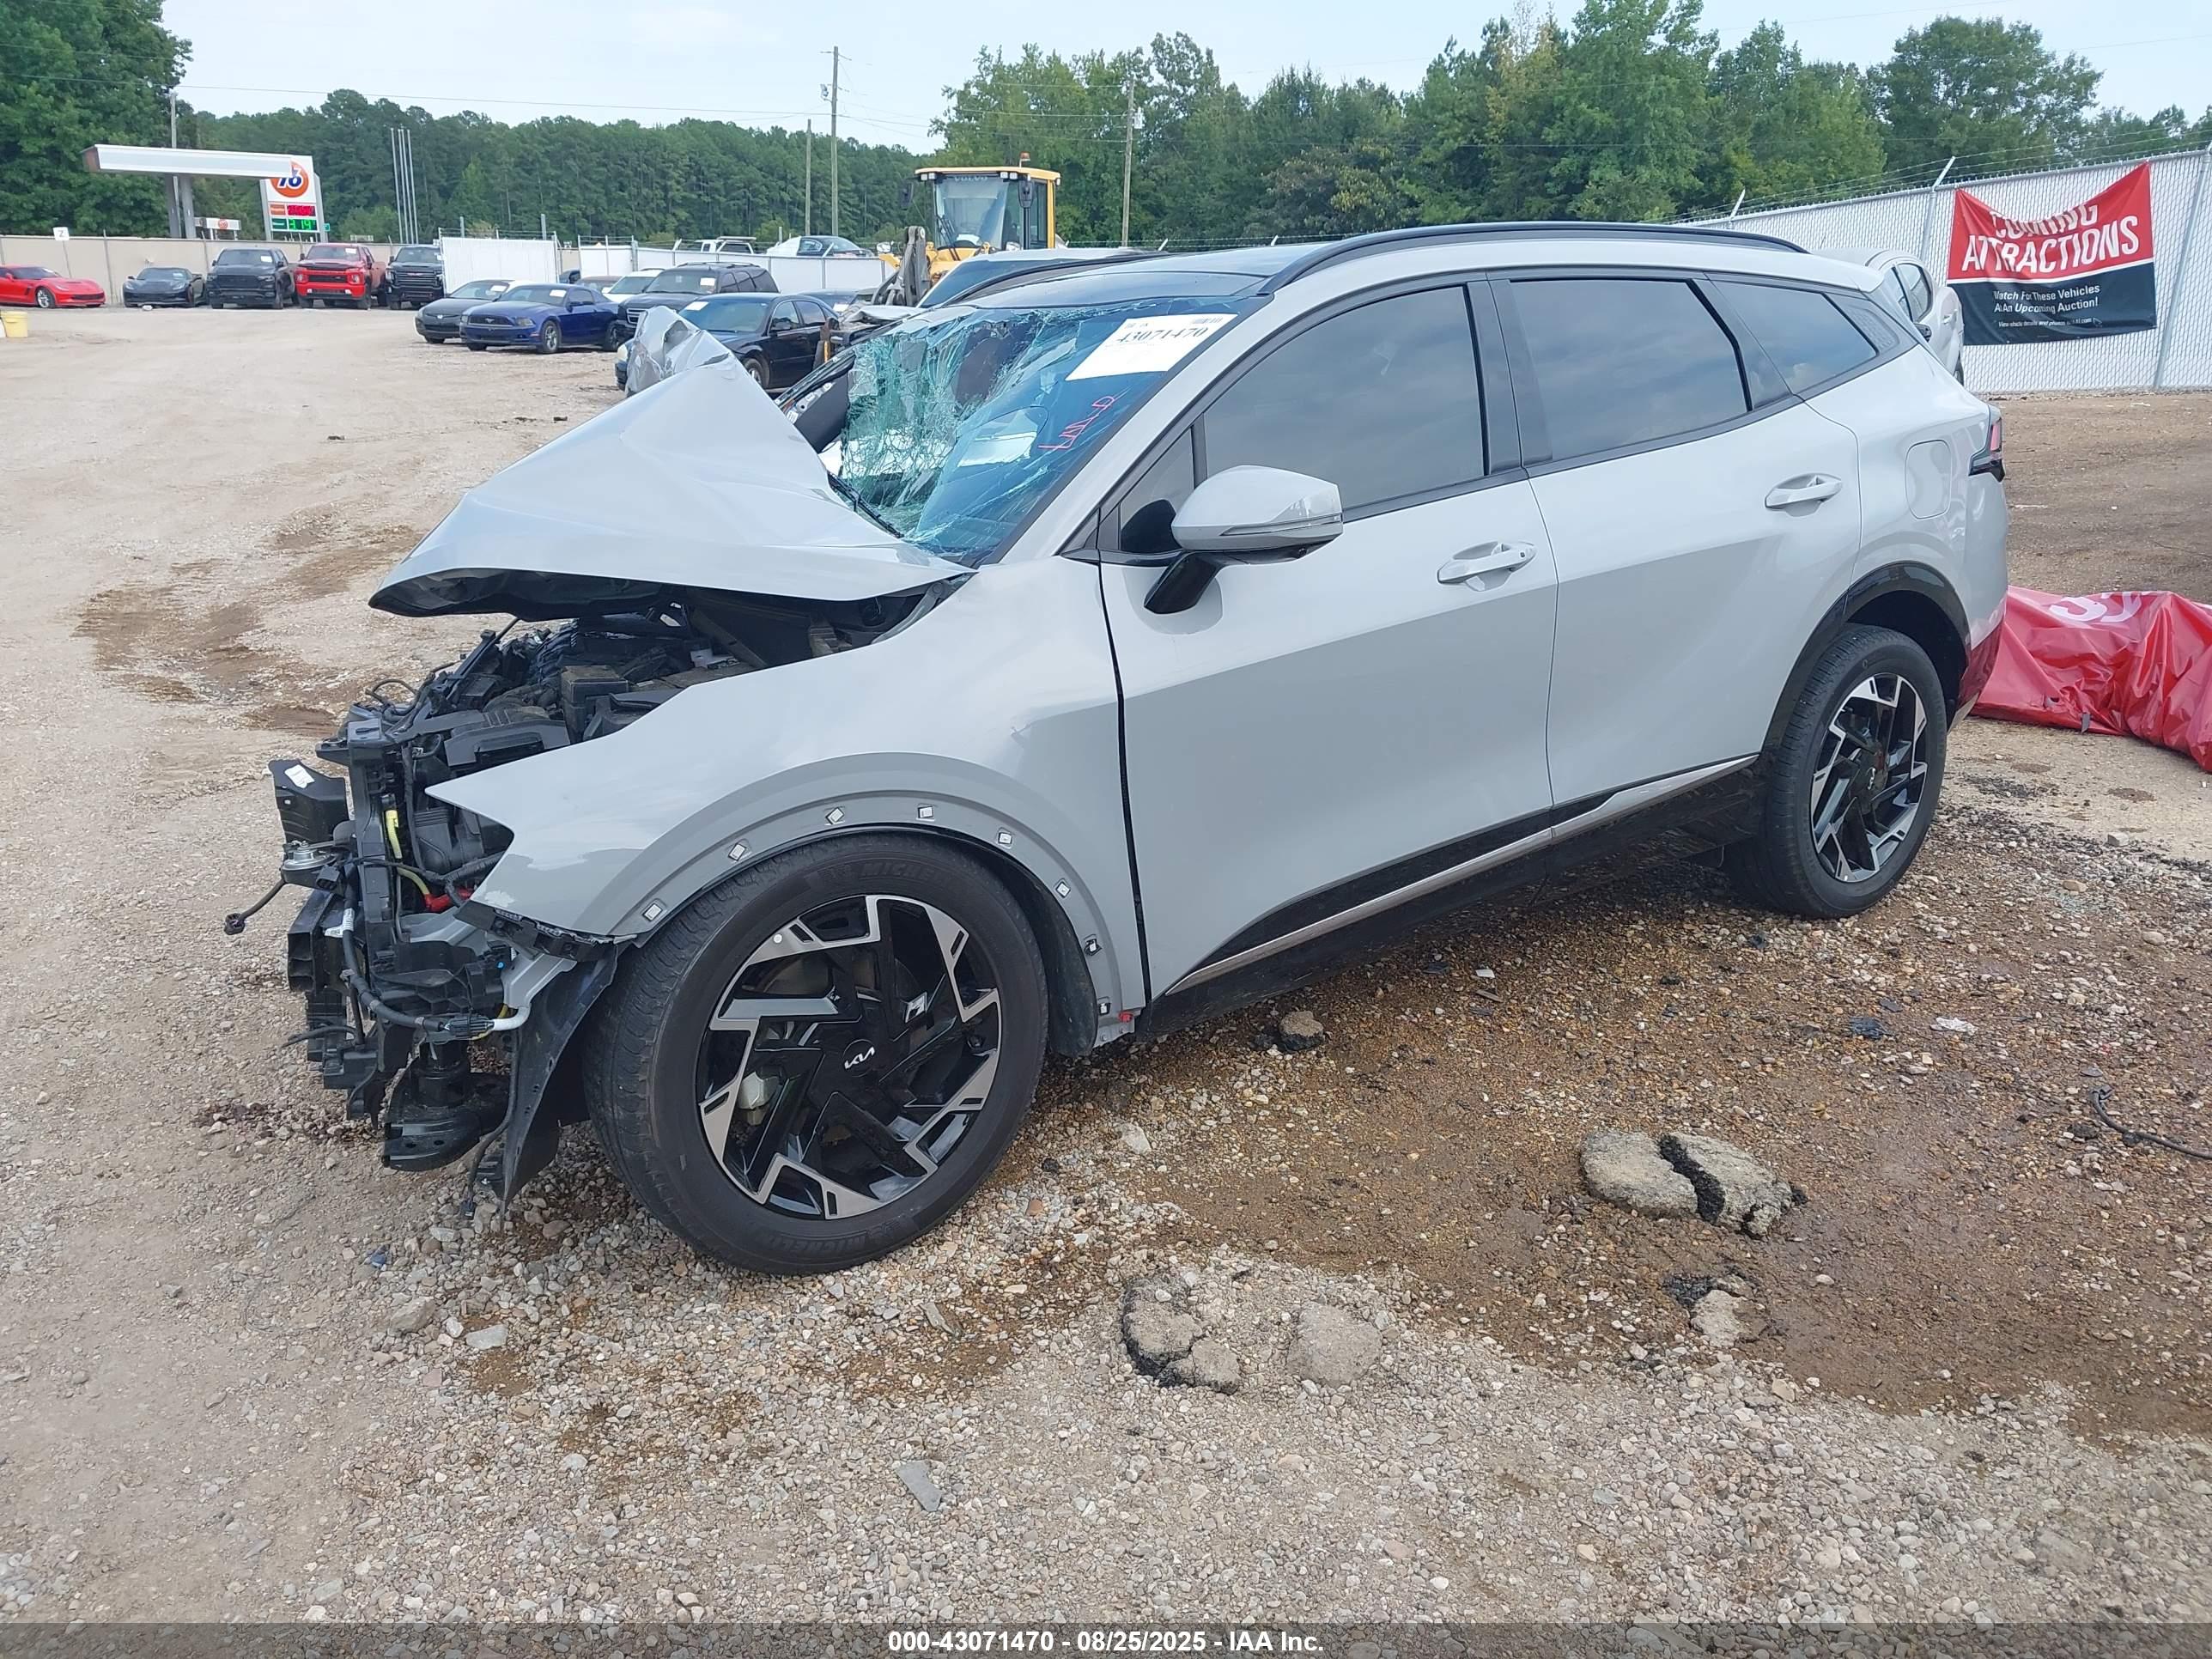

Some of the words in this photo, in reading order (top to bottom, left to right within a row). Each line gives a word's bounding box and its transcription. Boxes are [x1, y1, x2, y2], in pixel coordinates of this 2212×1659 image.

[1961, 216, 2139, 273] ATTRACTIONS
[2033, 291, 2057, 301] These
[2057, 284, 2100, 300] Vehicles
[2014, 303, 2056, 314] Upcoming
[2057, 296, 2099, 313] Auction!
[1115, 326, 1209, 343] 43071470
